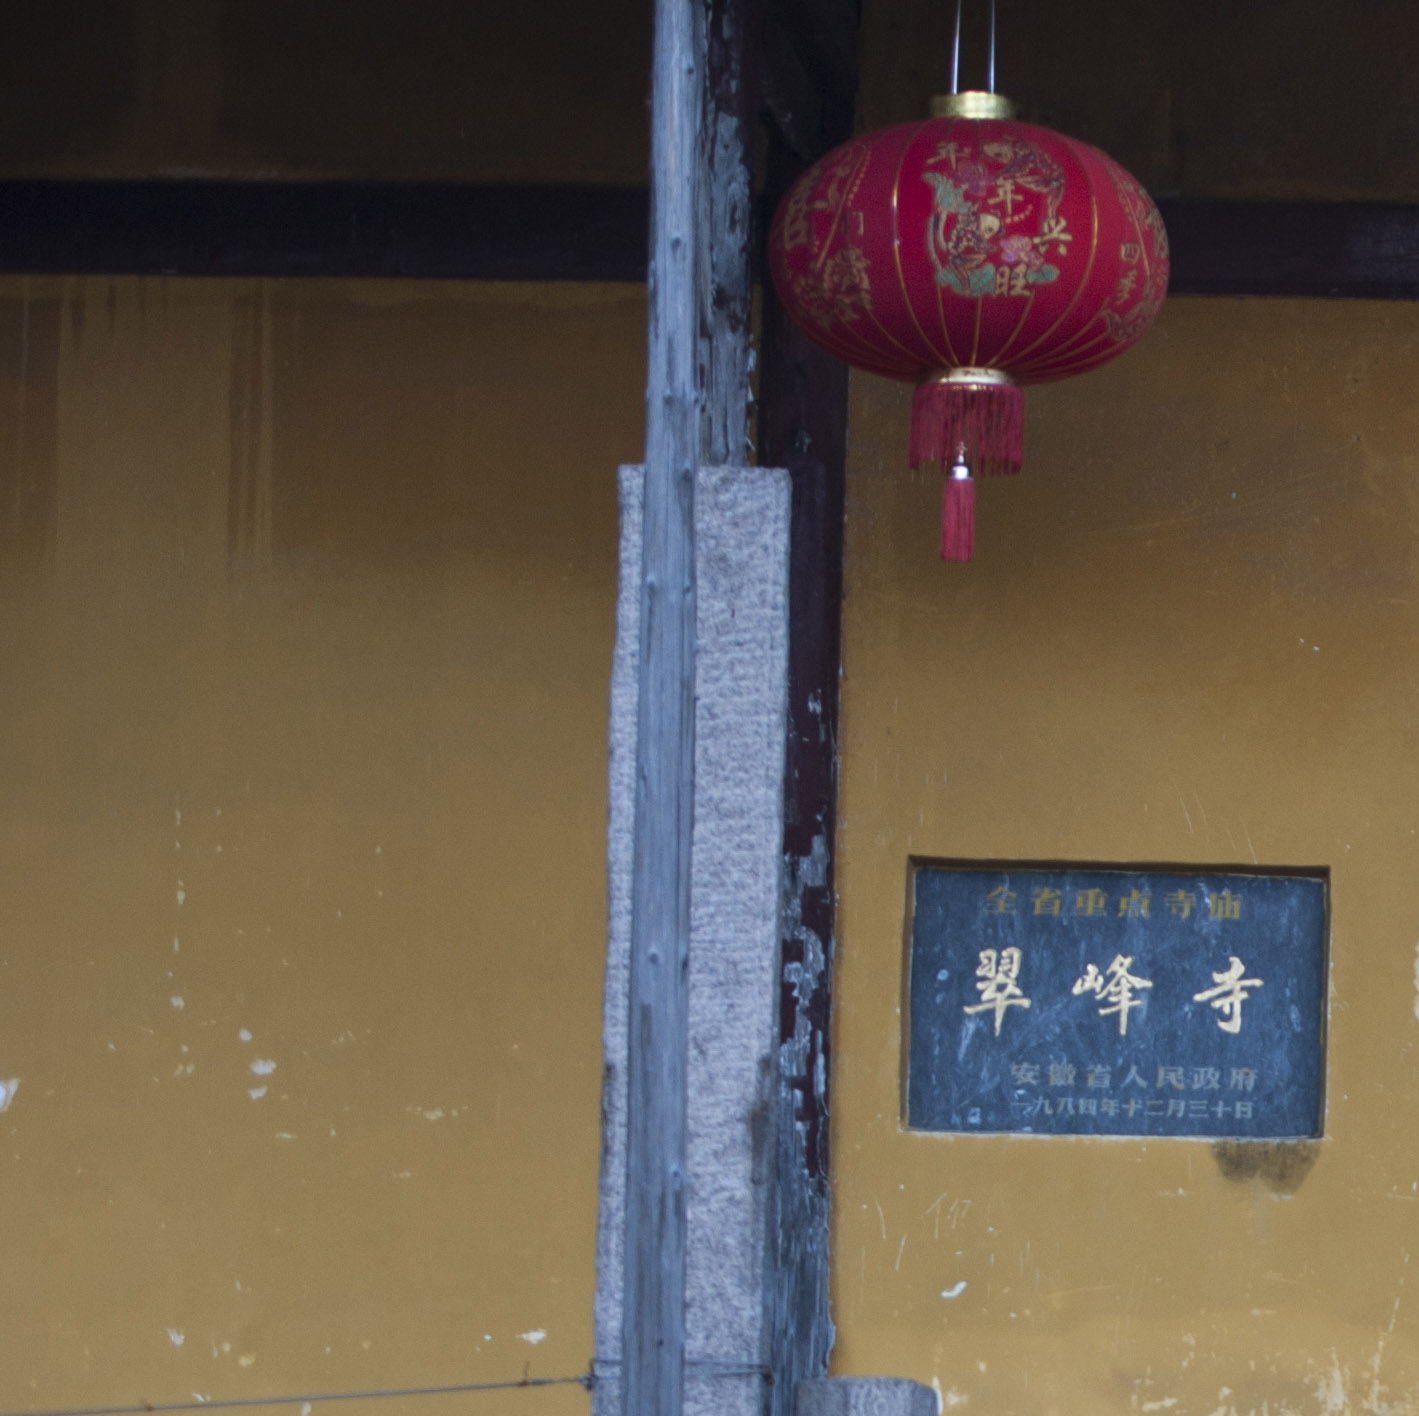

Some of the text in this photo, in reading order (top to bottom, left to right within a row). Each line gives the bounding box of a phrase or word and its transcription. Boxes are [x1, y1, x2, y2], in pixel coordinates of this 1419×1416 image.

[984, 885, 1243, 920] 全省重点寺庙
[962, 946, 1264, 1037] 翠峰寺
[1010, 1062, 1259, 1092] 安徽省人民政府
[1011, 1097, 1255, 1120] 一九八四年十二月三十日
